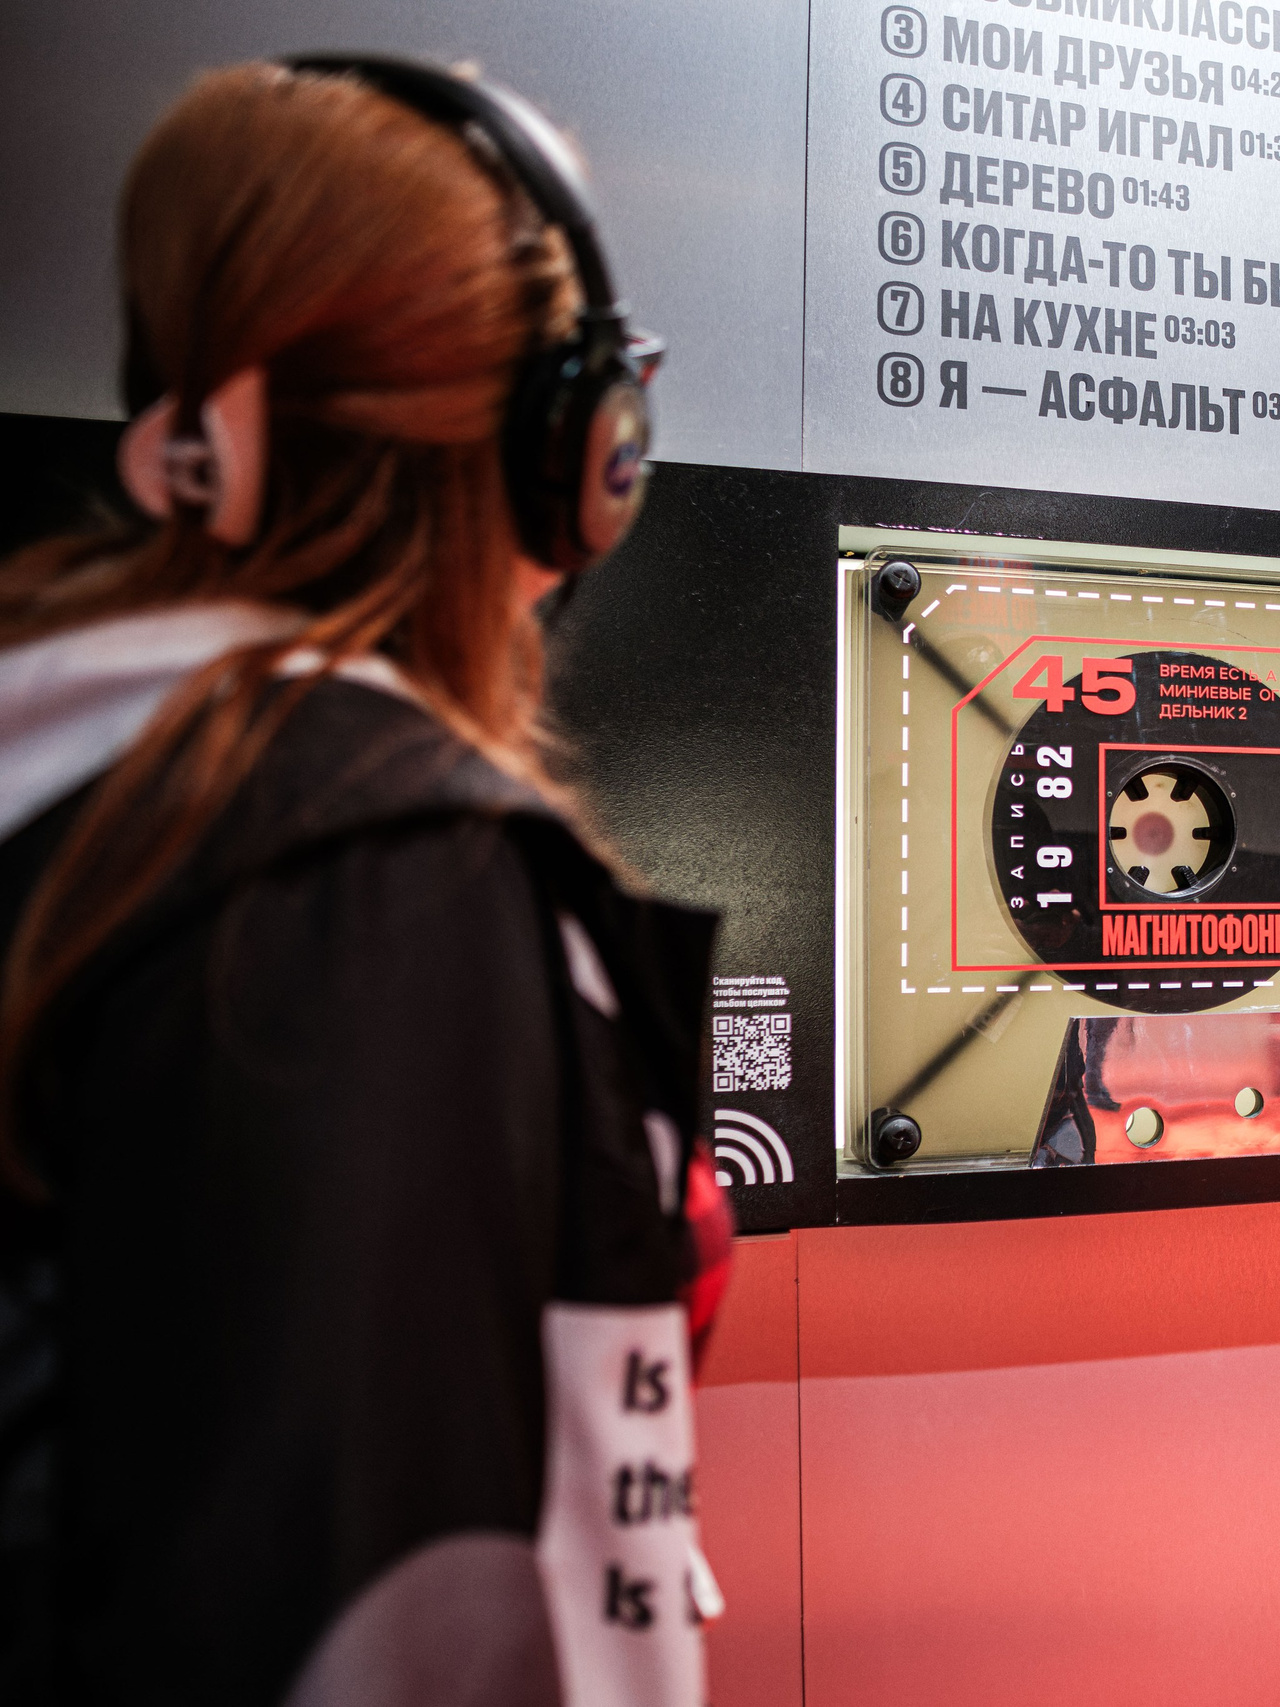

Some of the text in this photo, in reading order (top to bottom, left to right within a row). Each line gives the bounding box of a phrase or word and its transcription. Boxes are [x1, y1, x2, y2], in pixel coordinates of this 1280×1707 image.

[943, 15, 1043, 76] МОИ
[1054, 35, 1224, 106] ДРУЗЬЯ
[942, 83, 1086, 147] СИТАР
[1098, 107, 1233, 172] ИГРАЛ
[940, 151, 1115, 219] ДЕРЕВО
[1122, 177, 1190, 212] 01:43
[941, 219, 1156, 292] КОГДА-ТО
[1167, 248, 1232, 301] ТЫ
[941, 289, 1002, 343] НА
[1013, 297, 1157, 359] КУХНЕ
[1164, 315, 1236, 349] 03:03
[939, 360, 968, 410] Я
[1038, 370, 1246, 435] АСФАЛЬТ
[1012, 655, 1137, 715] 45
[1160, 664, 1215, 679] ВРЕМЯ
[1219, 667, 1262, 683] ЕСТЬ,
[1266, 670, 1277, 682] А
[1160, 684, 1251, 701] МИНИЕВЫЕ
[1159, 704, 1248, 720] ДЕЛЬНИК 2
[1010, 743, 1024, 909] ЗАПИСЬ
[713, 976, 786, 987] Сканируйте код,
[713, 987, 790, 997] чтобы послушать
[713, 999, 786, 1008] альбом целиком
